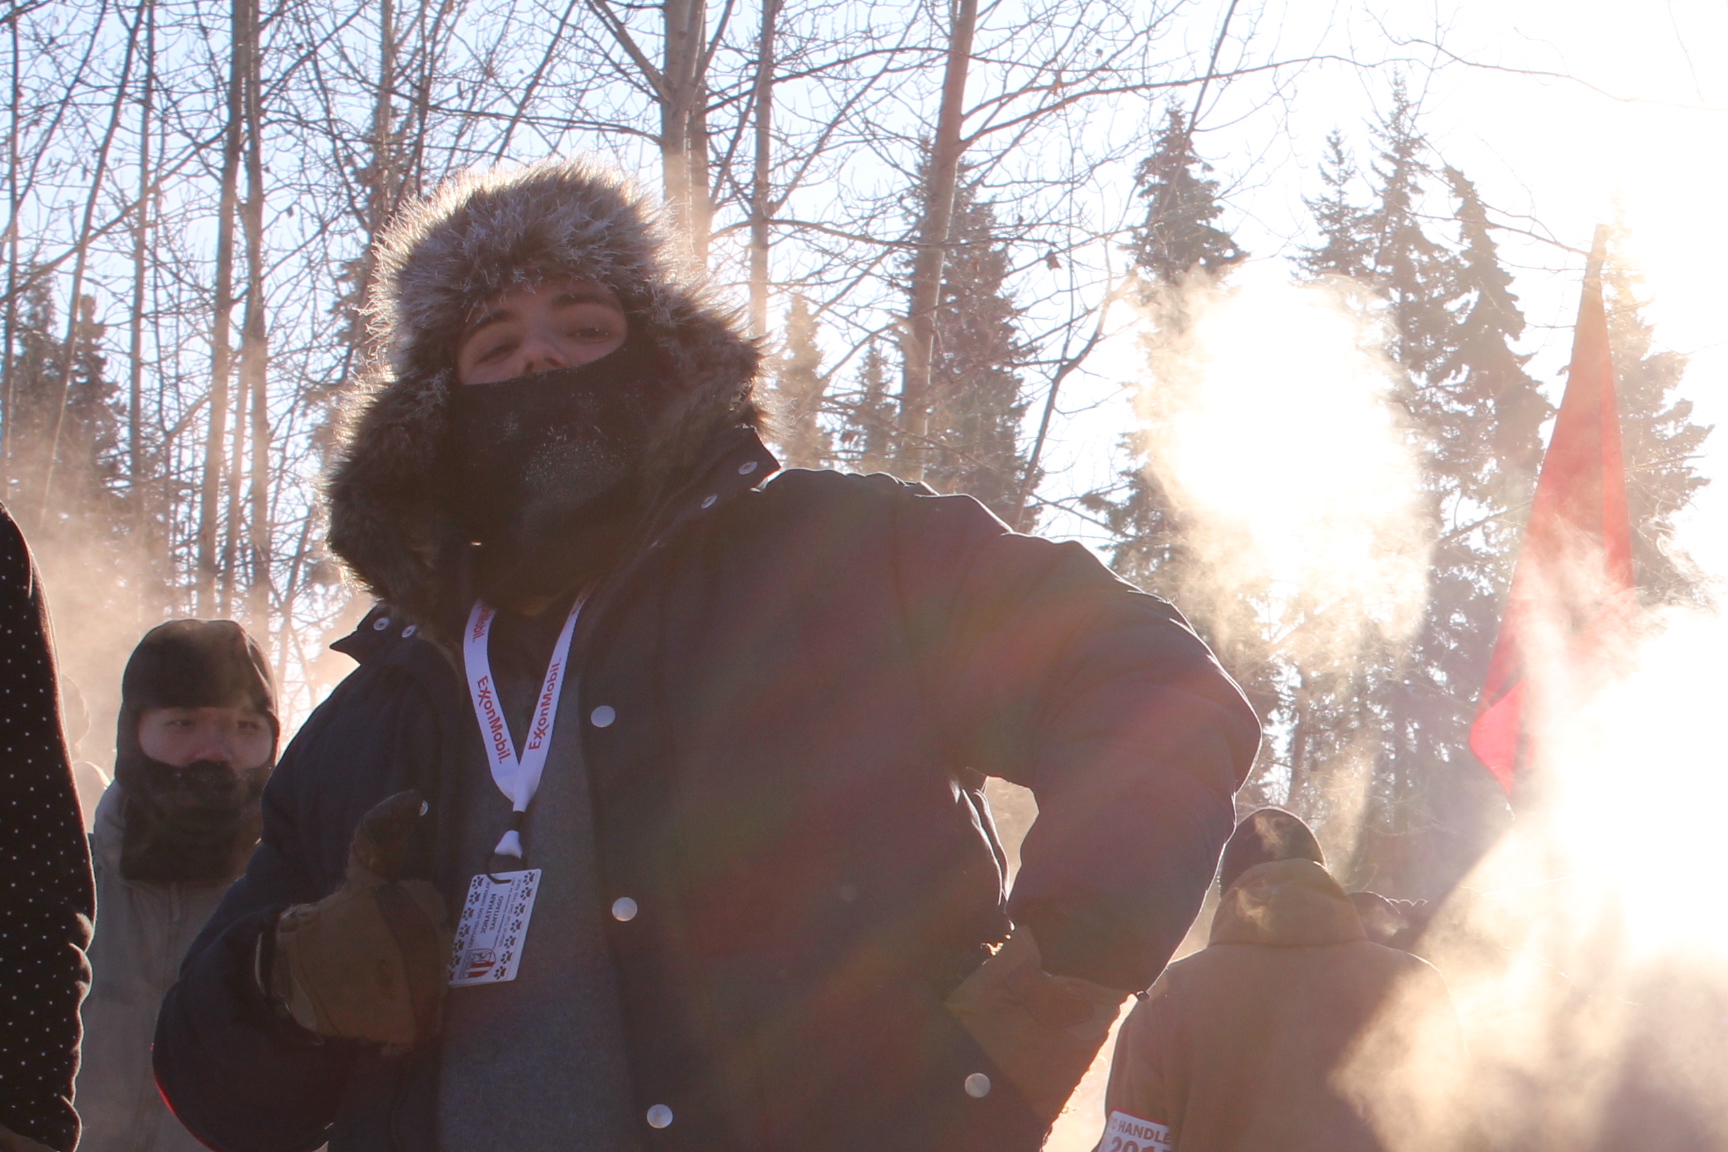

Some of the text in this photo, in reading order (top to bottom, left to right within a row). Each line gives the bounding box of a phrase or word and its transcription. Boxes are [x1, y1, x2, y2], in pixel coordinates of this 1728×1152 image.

[477, 676, 511, 761] ExxonMobil
[529, 662, 561, 750] ExxonMobil
[481, 893, 497, 934] JONATHAN
[490, 895, 504, 930] SANTIAGO
[1117, 1121, 1171, 1145] HANDLE
